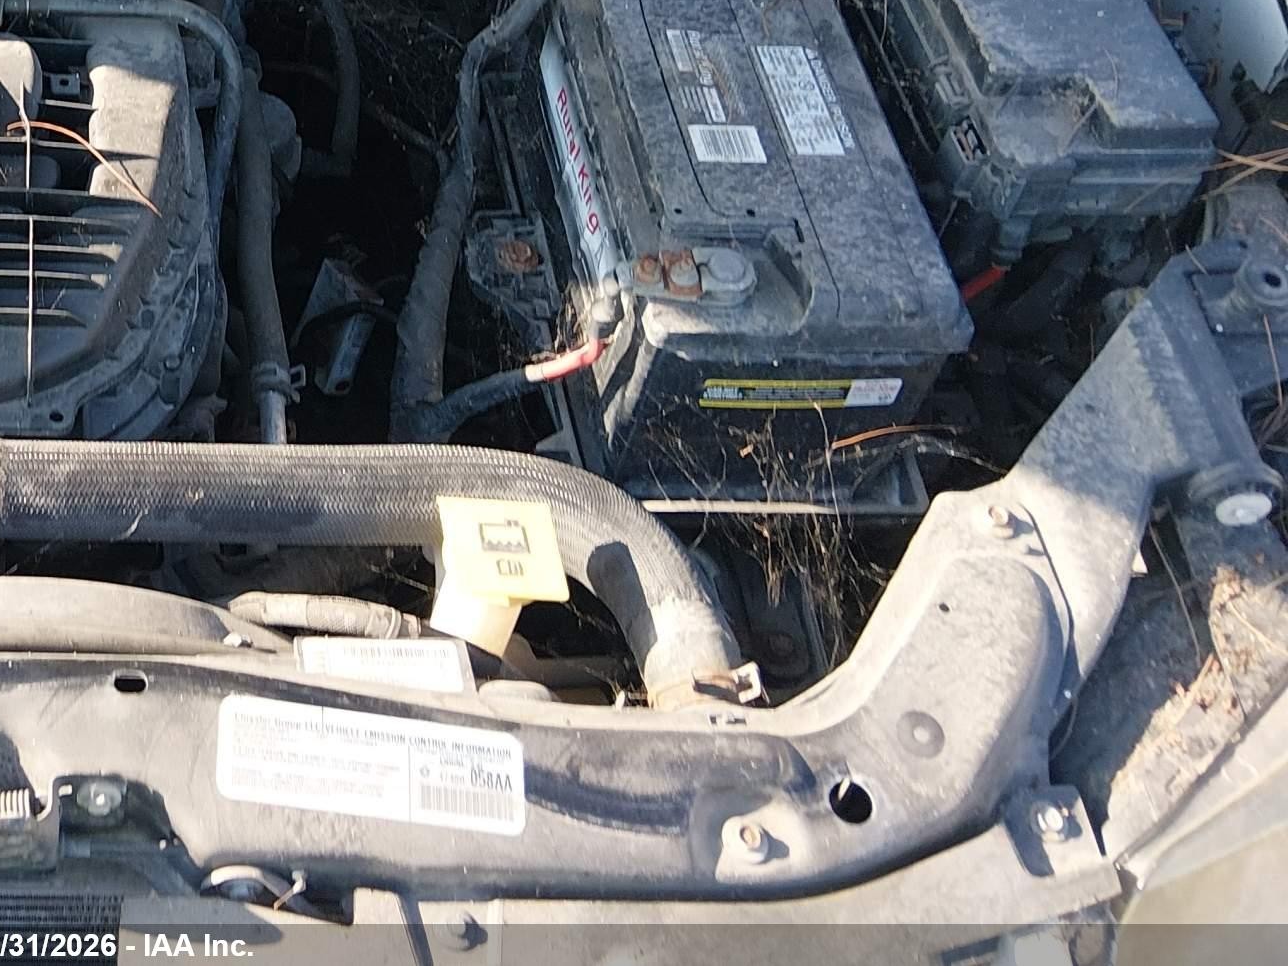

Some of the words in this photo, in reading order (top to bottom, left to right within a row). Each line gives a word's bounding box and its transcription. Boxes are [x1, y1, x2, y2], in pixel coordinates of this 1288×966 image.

[557, 88, 580, 160] Rural
[364, 729, 406, 744] EMISSION
[409, 736, 447, 750] CONTROL
[451, 742, 512, 760] INFORMATION
